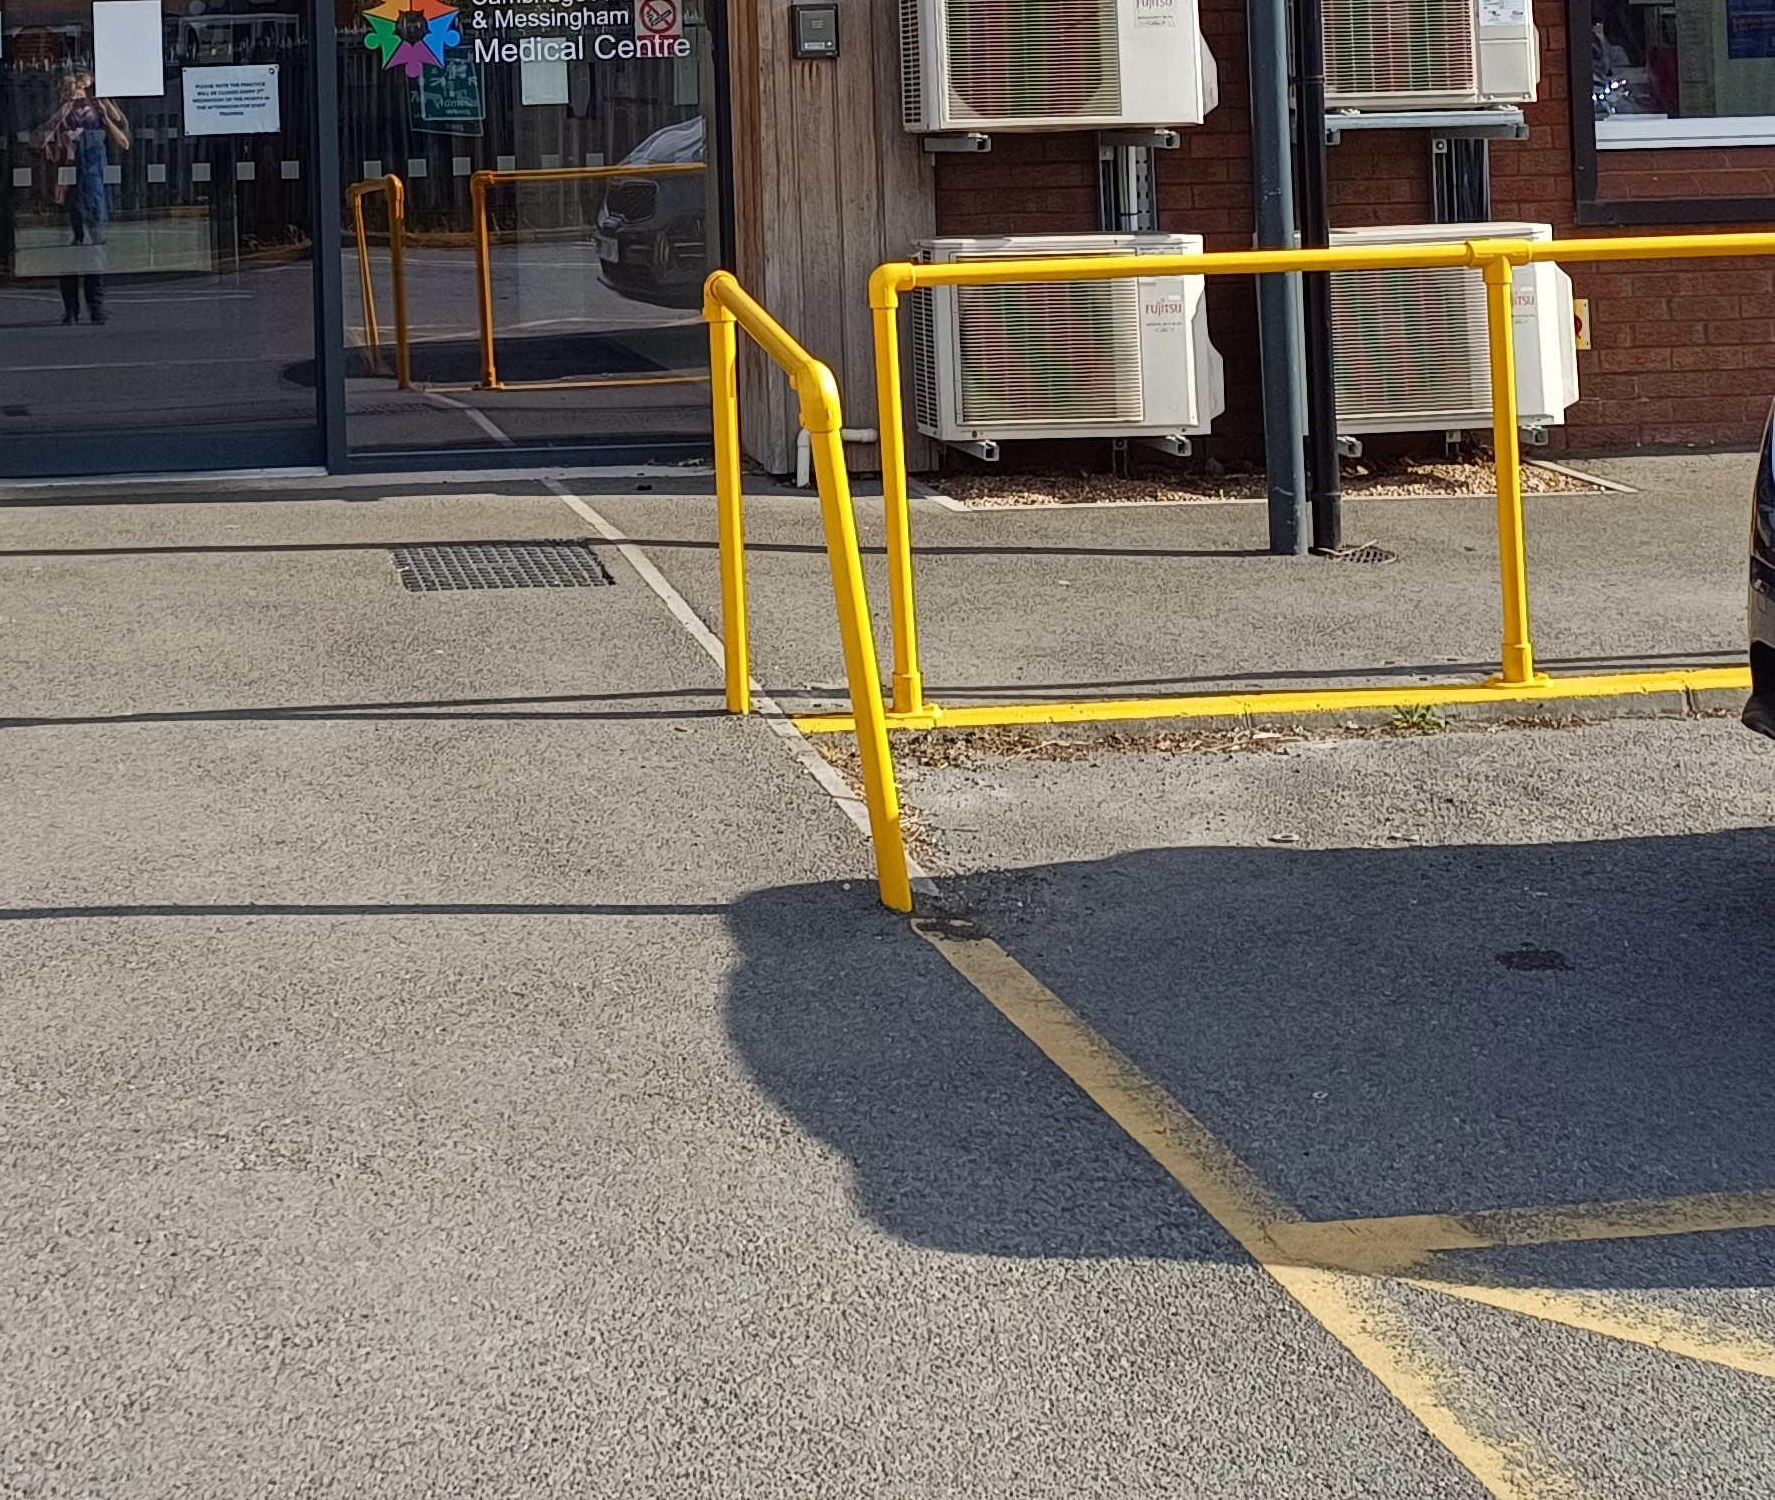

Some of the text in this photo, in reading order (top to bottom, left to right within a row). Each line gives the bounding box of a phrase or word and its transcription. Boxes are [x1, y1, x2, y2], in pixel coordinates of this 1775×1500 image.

[472, 7, 629, 30] & Messingham
[475, 36, 584, 63] Medical
[594, 34, 691, 60] Centre
[1145, 302, 1182, 317] FUJITSU
